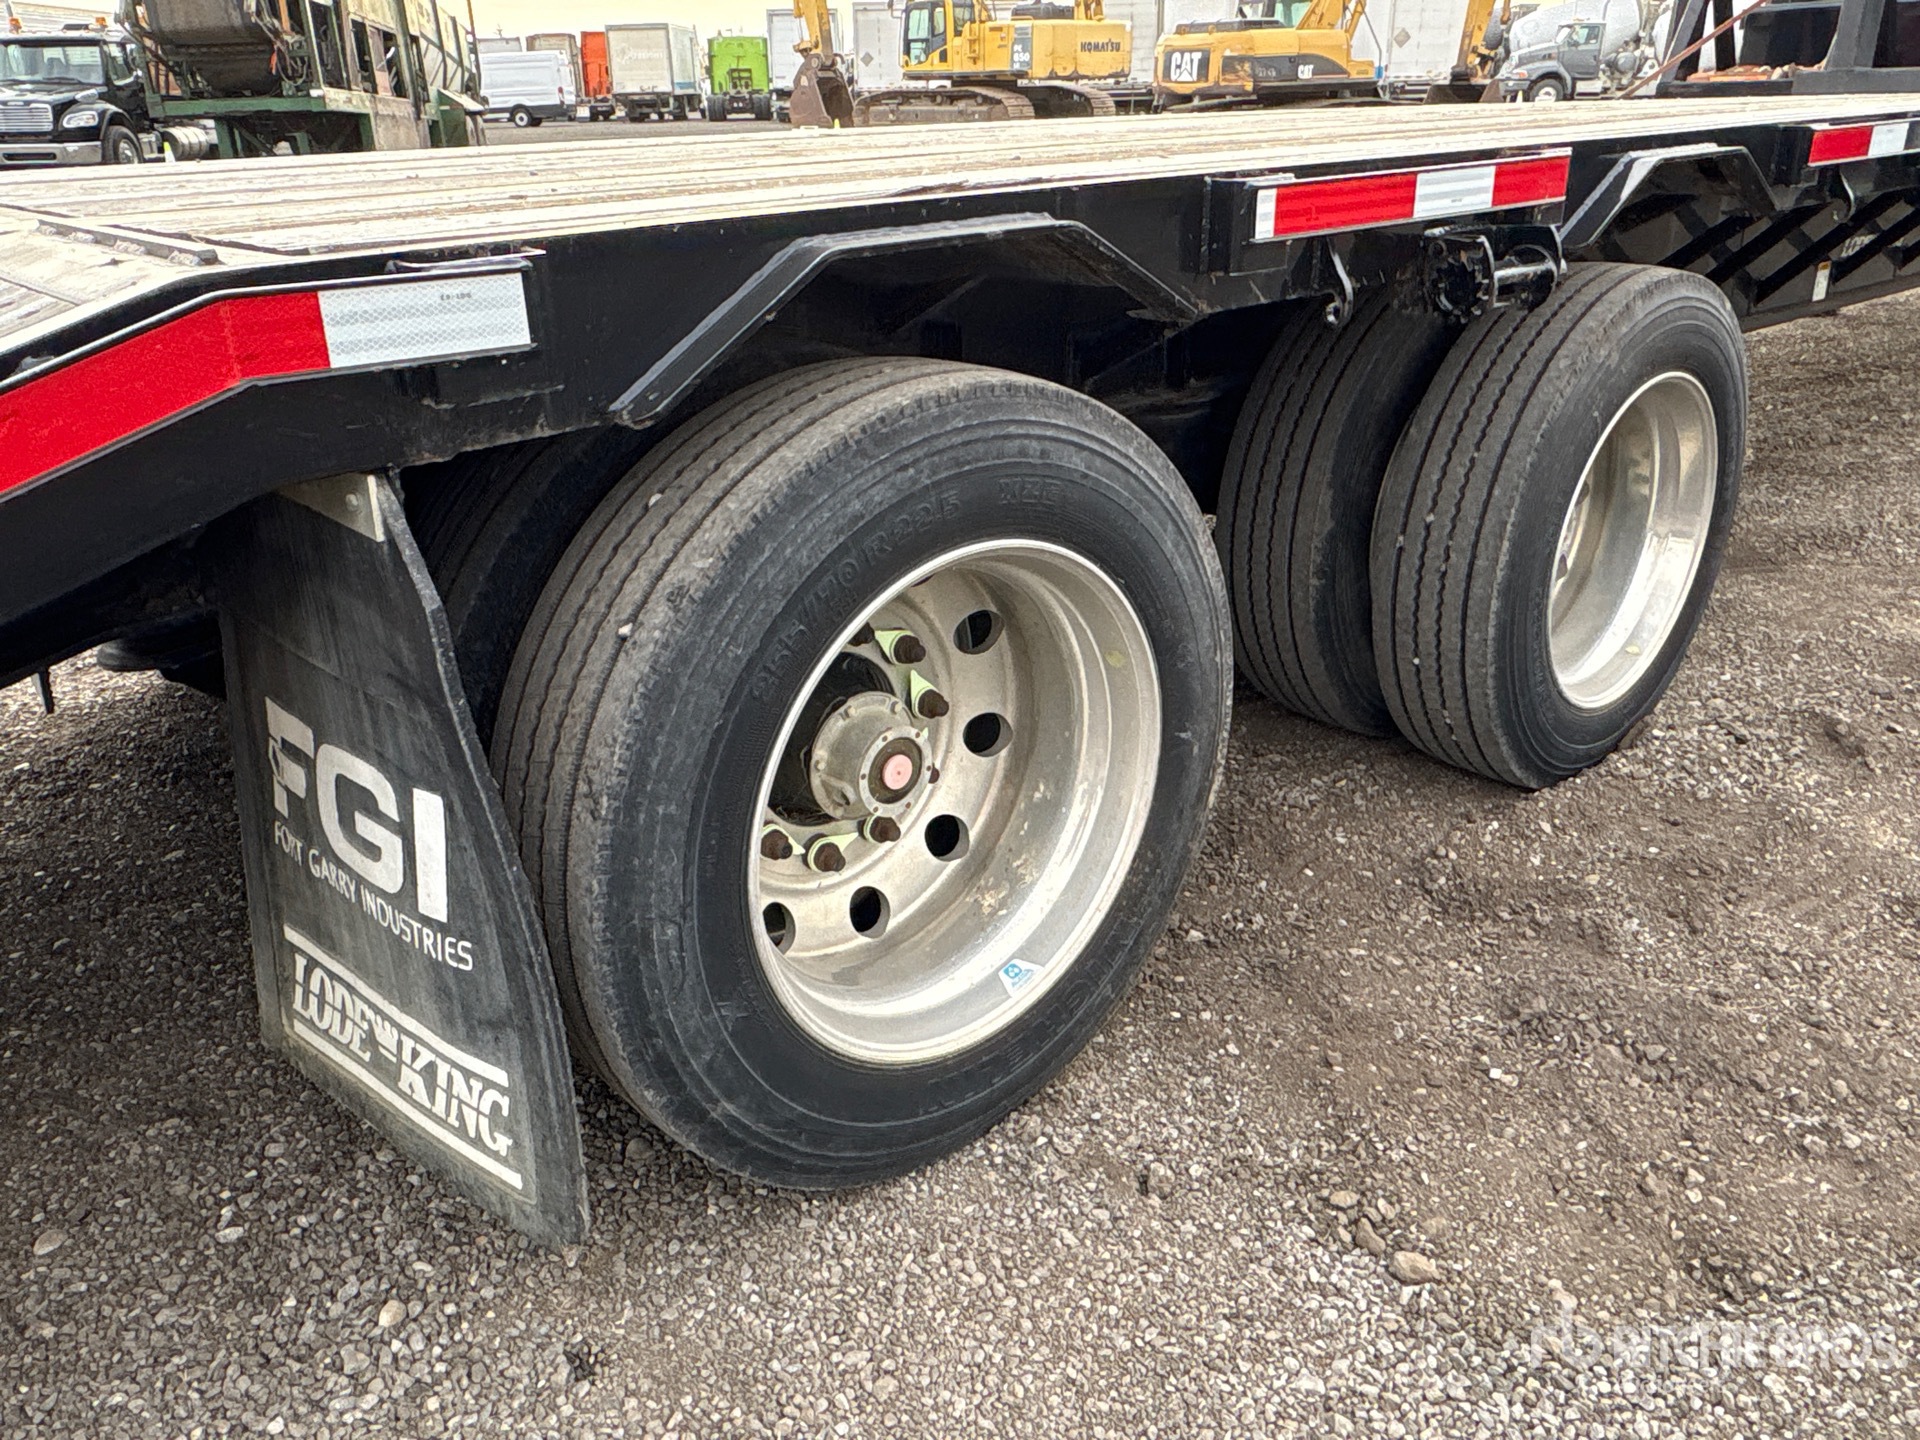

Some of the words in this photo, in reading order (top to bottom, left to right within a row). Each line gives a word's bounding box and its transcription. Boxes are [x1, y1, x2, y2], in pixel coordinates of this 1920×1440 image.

[1080, 38, 1121, 53] KOMATSU
[1170, 52, 1202, 81] CAT
[264, 696, 449, 924] FGI
[273, 819, 304, 867] FORT
[308, 841, 357, 905] GARRY
[360, 891, 474, 972] INDUSTRIES
[397, 1031, 513, 1157] KING
